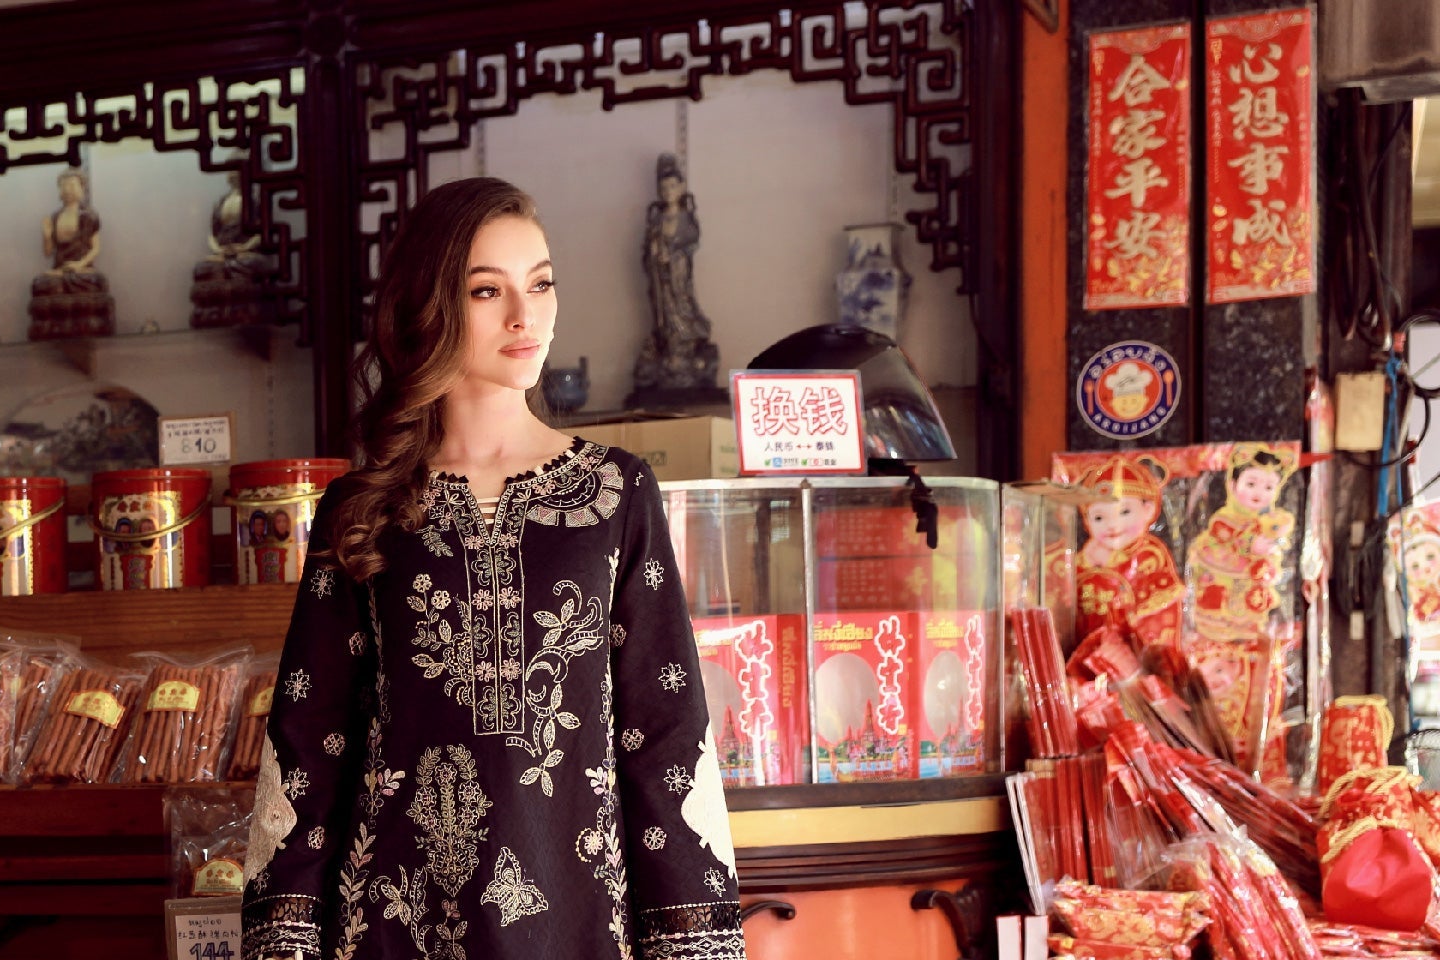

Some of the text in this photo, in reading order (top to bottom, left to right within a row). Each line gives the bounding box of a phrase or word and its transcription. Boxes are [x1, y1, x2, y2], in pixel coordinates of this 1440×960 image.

[1103, 53, 1171, 260] 合家平安
[1227, 43, 1293, 247] 心想事成
[751, 386, 848, 435] 换钱
